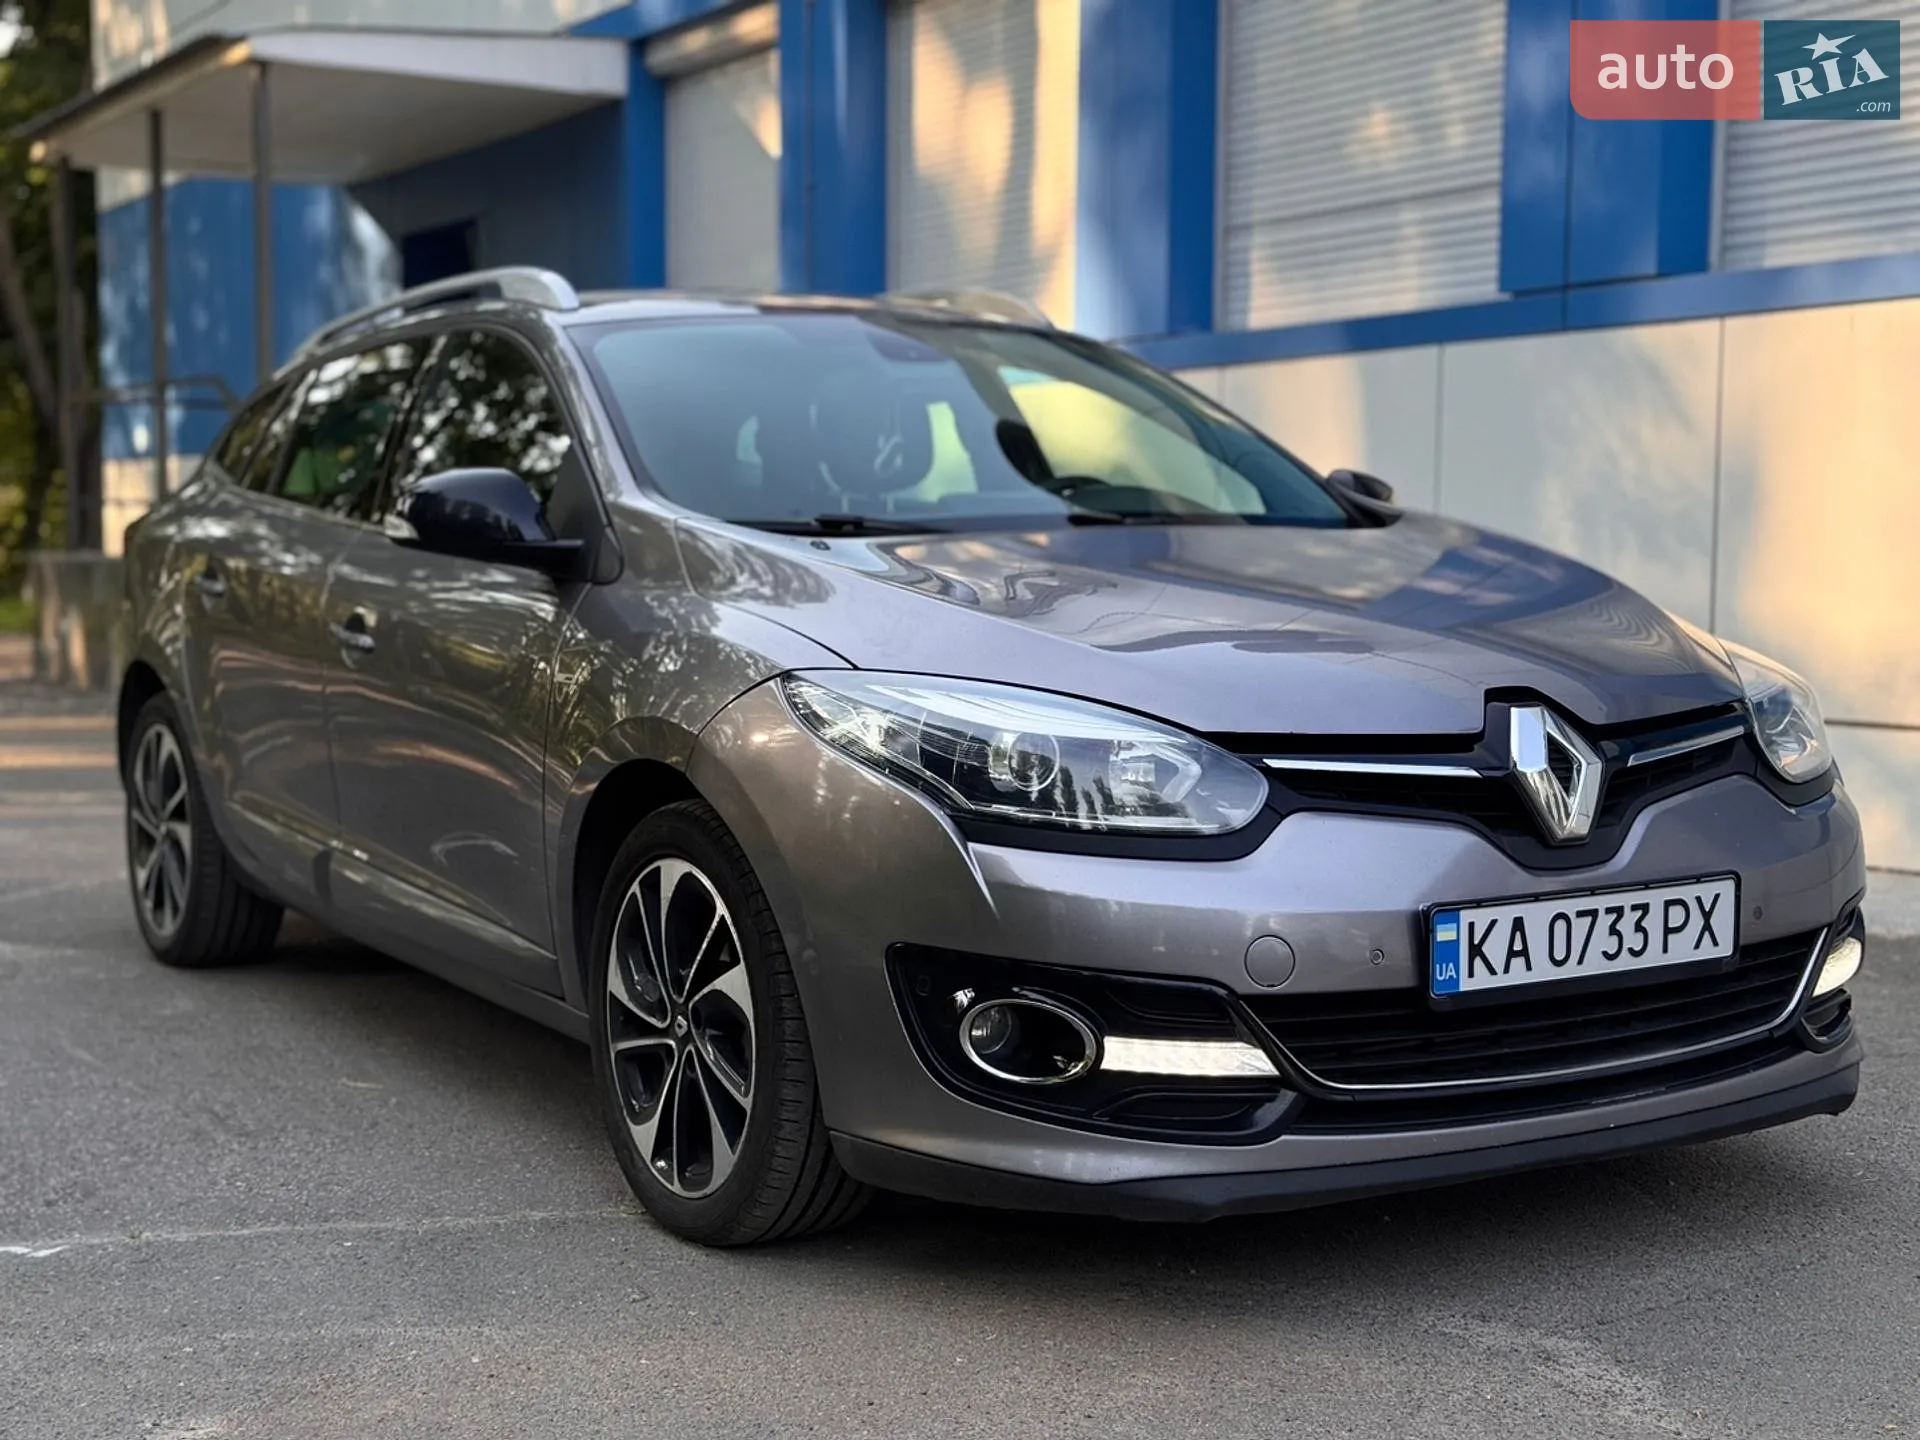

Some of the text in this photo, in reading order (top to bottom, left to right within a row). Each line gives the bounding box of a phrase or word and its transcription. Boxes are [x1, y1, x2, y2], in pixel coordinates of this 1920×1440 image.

[1467, 892, 1721, 978] KA 0733 PX
[1436, 963, 1457, 980] UA
